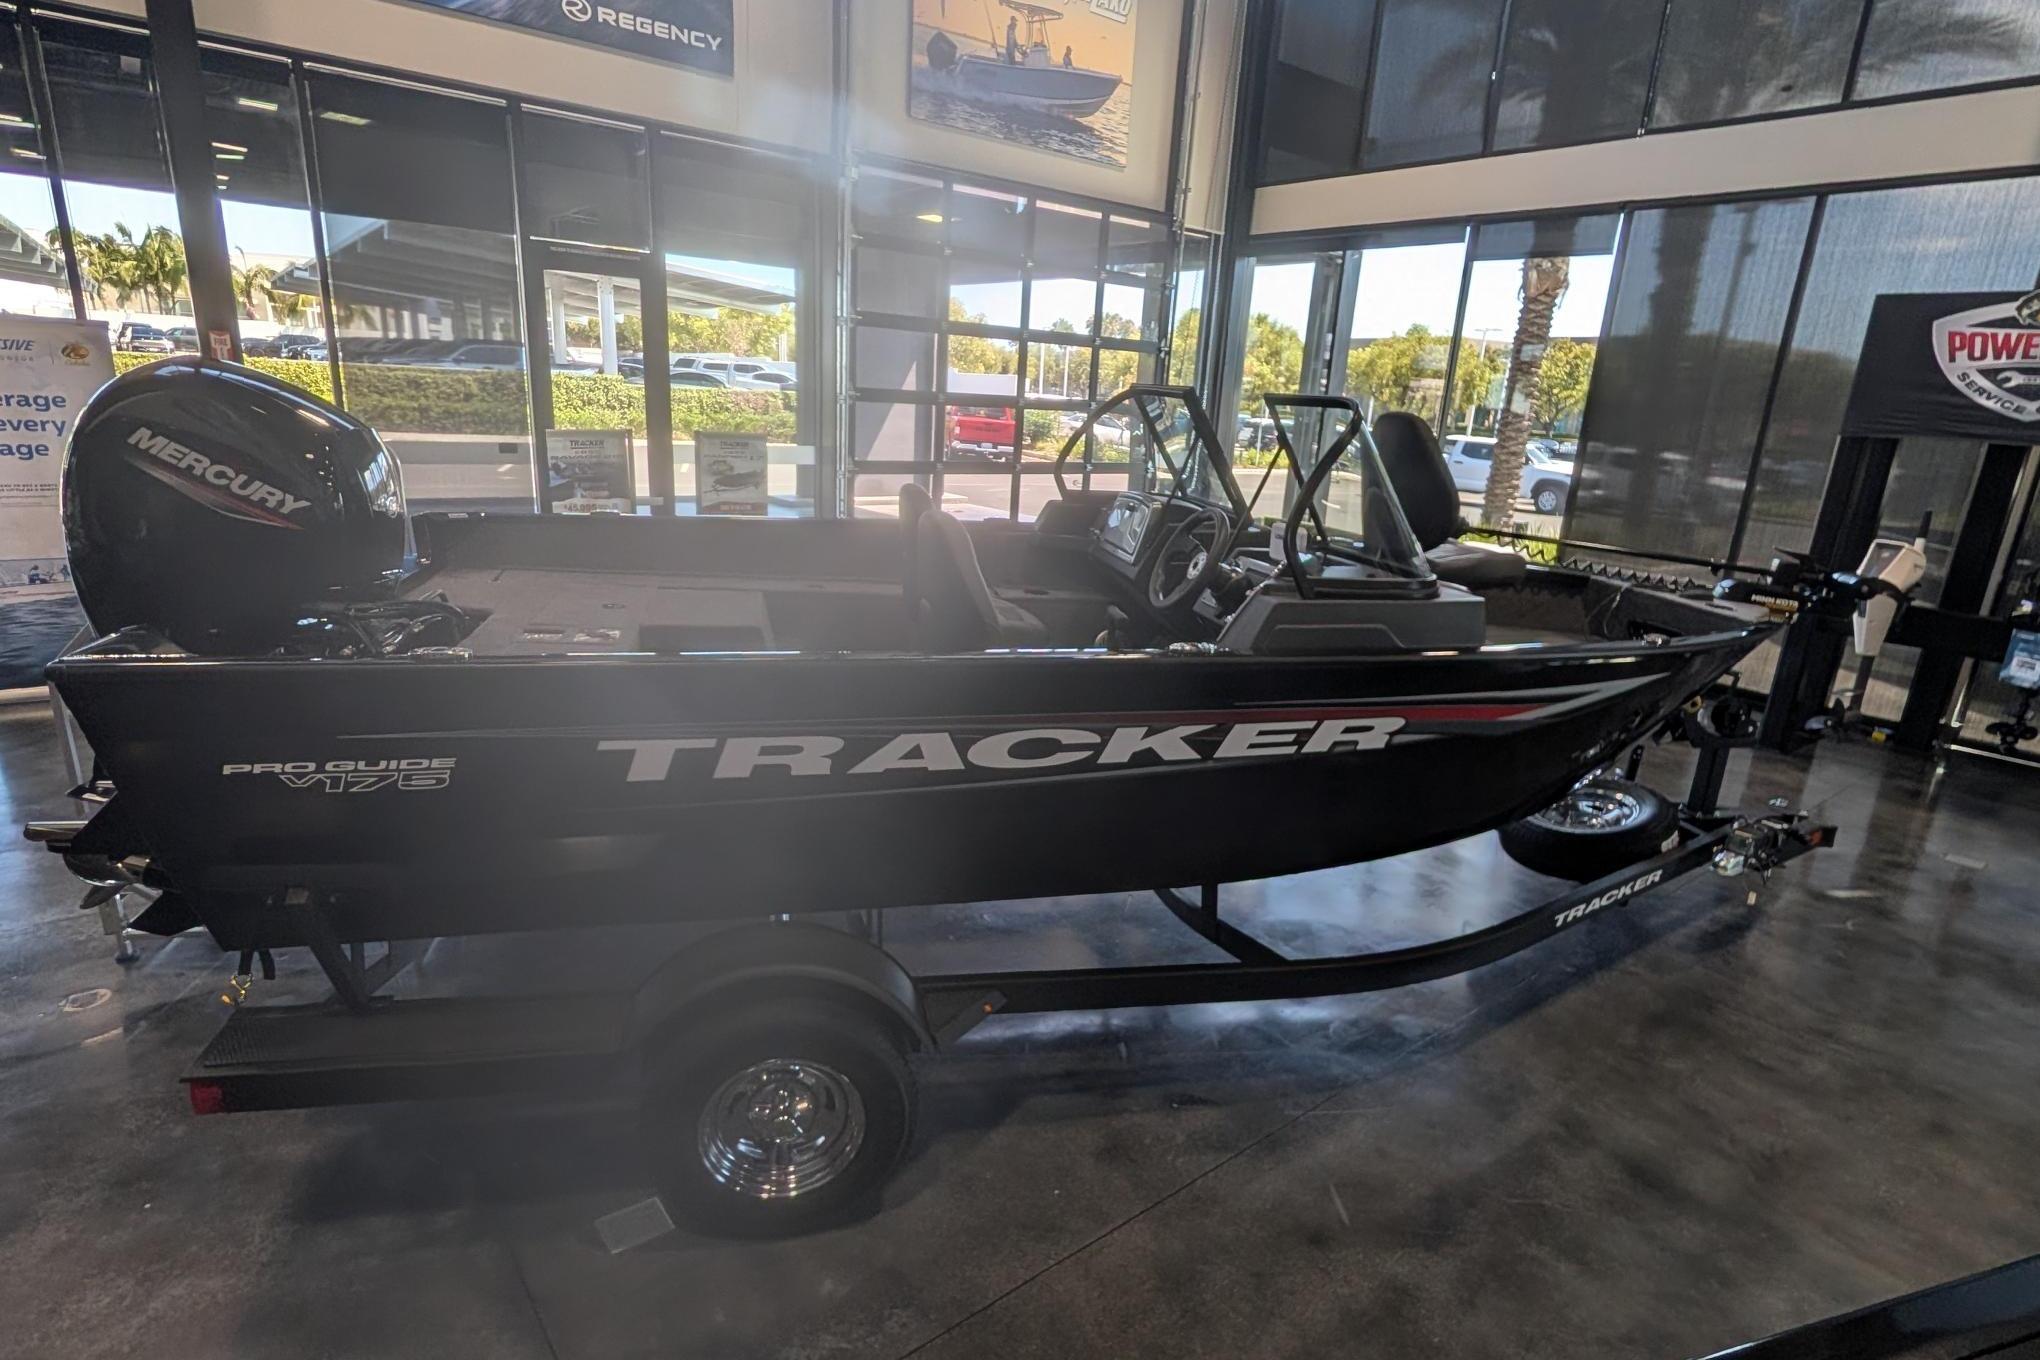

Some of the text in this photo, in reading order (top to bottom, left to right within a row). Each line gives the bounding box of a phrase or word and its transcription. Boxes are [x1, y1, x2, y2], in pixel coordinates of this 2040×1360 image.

[597, 6, 723, 51] REGENCY
[0, 338, 35, 351] SIVE
[0, 394, 67, 412] rage
[1957, 372, 2028, 414] SERVICE
[127, 426, 312, 514] MERCURY
[222, 758, 457, 775] PRO GUIDE
[597, 716, 1407, 783] TRACKER
[279, 769, 450, 793] V175
[1554, 869, 1663, 928] TRACKER
